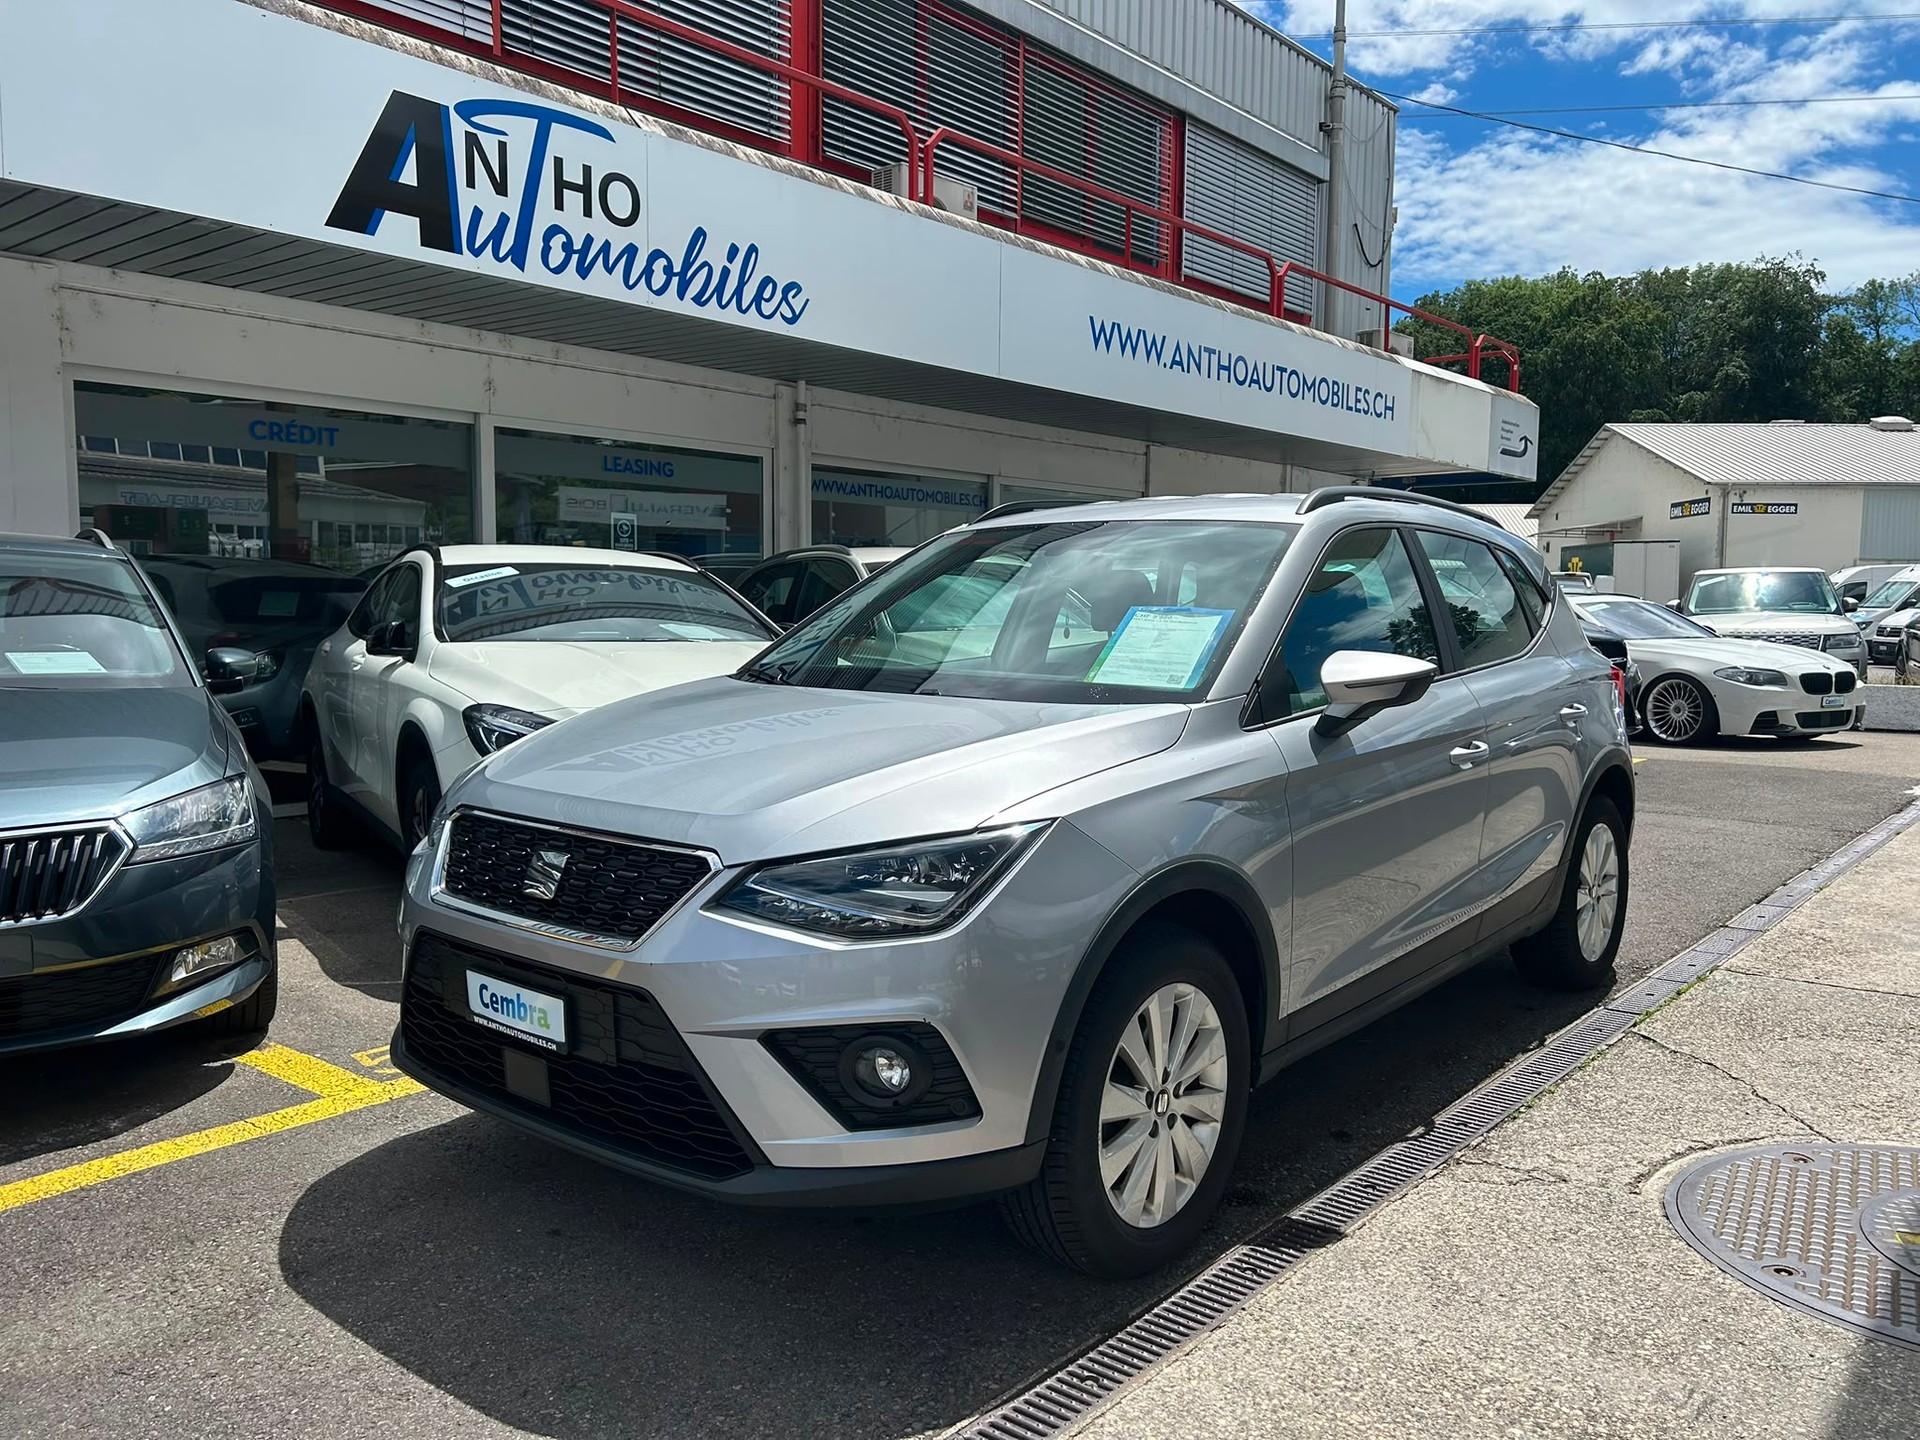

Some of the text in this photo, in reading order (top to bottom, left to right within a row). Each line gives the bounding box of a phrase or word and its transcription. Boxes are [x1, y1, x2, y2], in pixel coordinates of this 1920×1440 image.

[1089, 315, 1396, 421] WWW.ANTHOAUTOMOBILES.CH
[249, 418, 340, 448] CRÉDIT
[603, 454, 674, 478] LEASING
[811, 479, 988, 508] WWW.ANTHOAUTOMOBILES.CH
[1670, 502, 1709, 517] EMIL EGGER
[1733, 505, 1796, 513] EMIL EGGER
[478, 983, 551, 1030] Cembra
[473, 1015, 557, 1051] WWW.ANTHOAUTOMOBILES.CH
